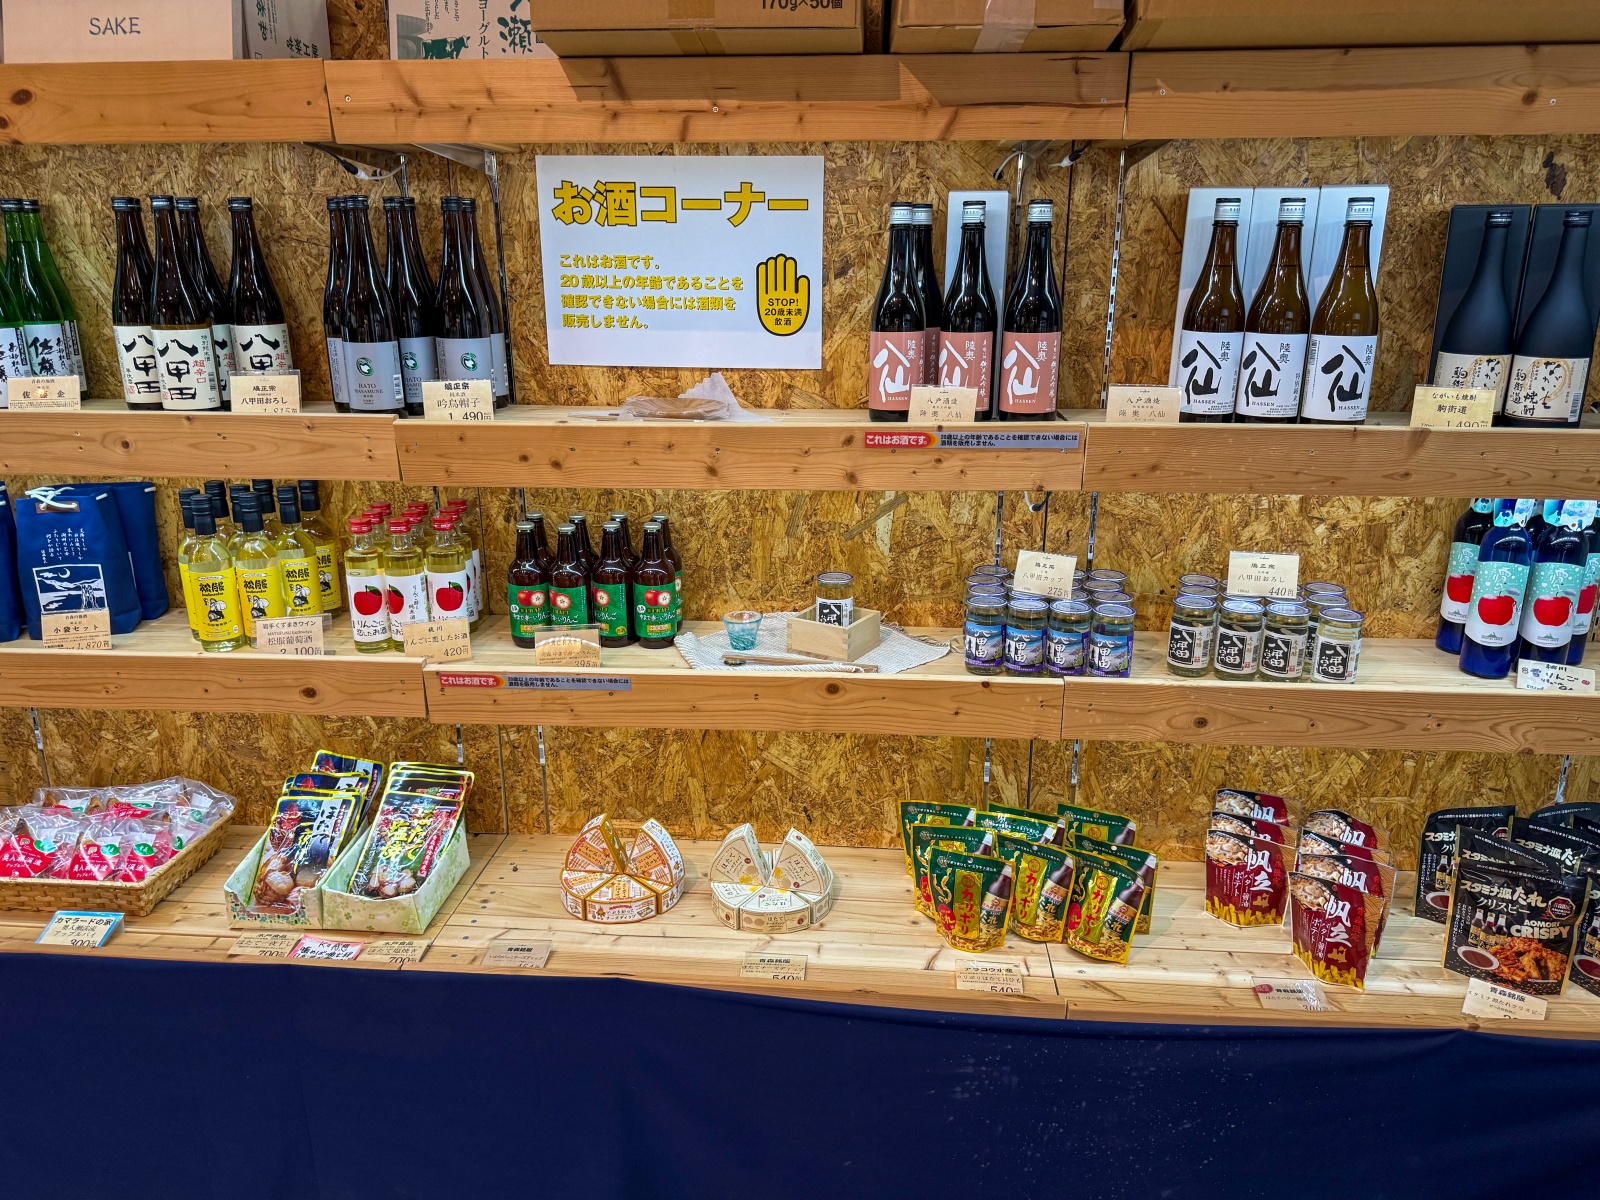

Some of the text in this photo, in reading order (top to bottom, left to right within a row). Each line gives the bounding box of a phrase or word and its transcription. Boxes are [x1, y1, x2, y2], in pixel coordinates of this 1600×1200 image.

[89, 17, 141, 35] SAKE
[552, 180, 809, 228] お酒コーナー
[559, 254, 660, 270] これはお酒です。
[560, 274, 744, 291] 20歳以上の年齢であることを
[561, 294, 736, 311] 確認できない場合には酒類を
[768, 297, 799, 307] STOP!
[764, 308, 802, 317] 20歳未満
[562, 314, 650, 330] 販売しません。
[774, 318, 792, 326] 飲酒
[1218, 341, 1231, 361] 陸奥
[1278, 343, 1291, 363] 陸奥
[157, 339, 199, 401] 八甲田
[193, 360, 206, 383] 超辛口
[1451, 366, 1467, 389] 駒街
[445, 382, 469, 390] 鳩正宗
[241, 397, 288, 405] 八甲田おろし
[1432, 393, 1477, 401] ながいも焼酎
[449, 412, 491, 420] 1490円
[1437, 404, 1467, 414] 駒街道
[866, 434, 928, 445] これはお酒です。
[1238, 574, 1285, 582] 八甲田おろし
[1047, 586, 1069, 597] 275円
[1268, 587, 1293, 596] 440円
[54, 624, 98, 634] 小袋セット
[263, 621, 316, 629] 岩手くずまきワイン
[357, 620, 384, 629] りんごに
[404, 633, 468, 646] りんごに恋したお酒
[443, 647, 469, 658] 420円
[441, 676, 497, 687] これはお酒です。
[1515, 839, 1584, 866] スタミナ源た
[1245, 847, 1274, 893] 帆立
[1234, 871, 1243, 897] ポテト
[1241, 871, 1253, 908] バター醤油
[1020, 873, 1037, 920] カリポリ
[1460, 880, 1547, 907] スタミナ源たれ
[960, 889, 976, 935] カリポリ
[1083, 889, 1105, 937] カリポリ
[1477, 897, 1530, 914] クリスピー
[55, 917, 113, 926] カマラードの家
[1324, 895, 1352, 947] 帆立
[1523, 919, 1560, 927] AOMORI
[1311, 917, 1322, 943] ポテト
[1510, 925, 1570, 940] CRISPY
